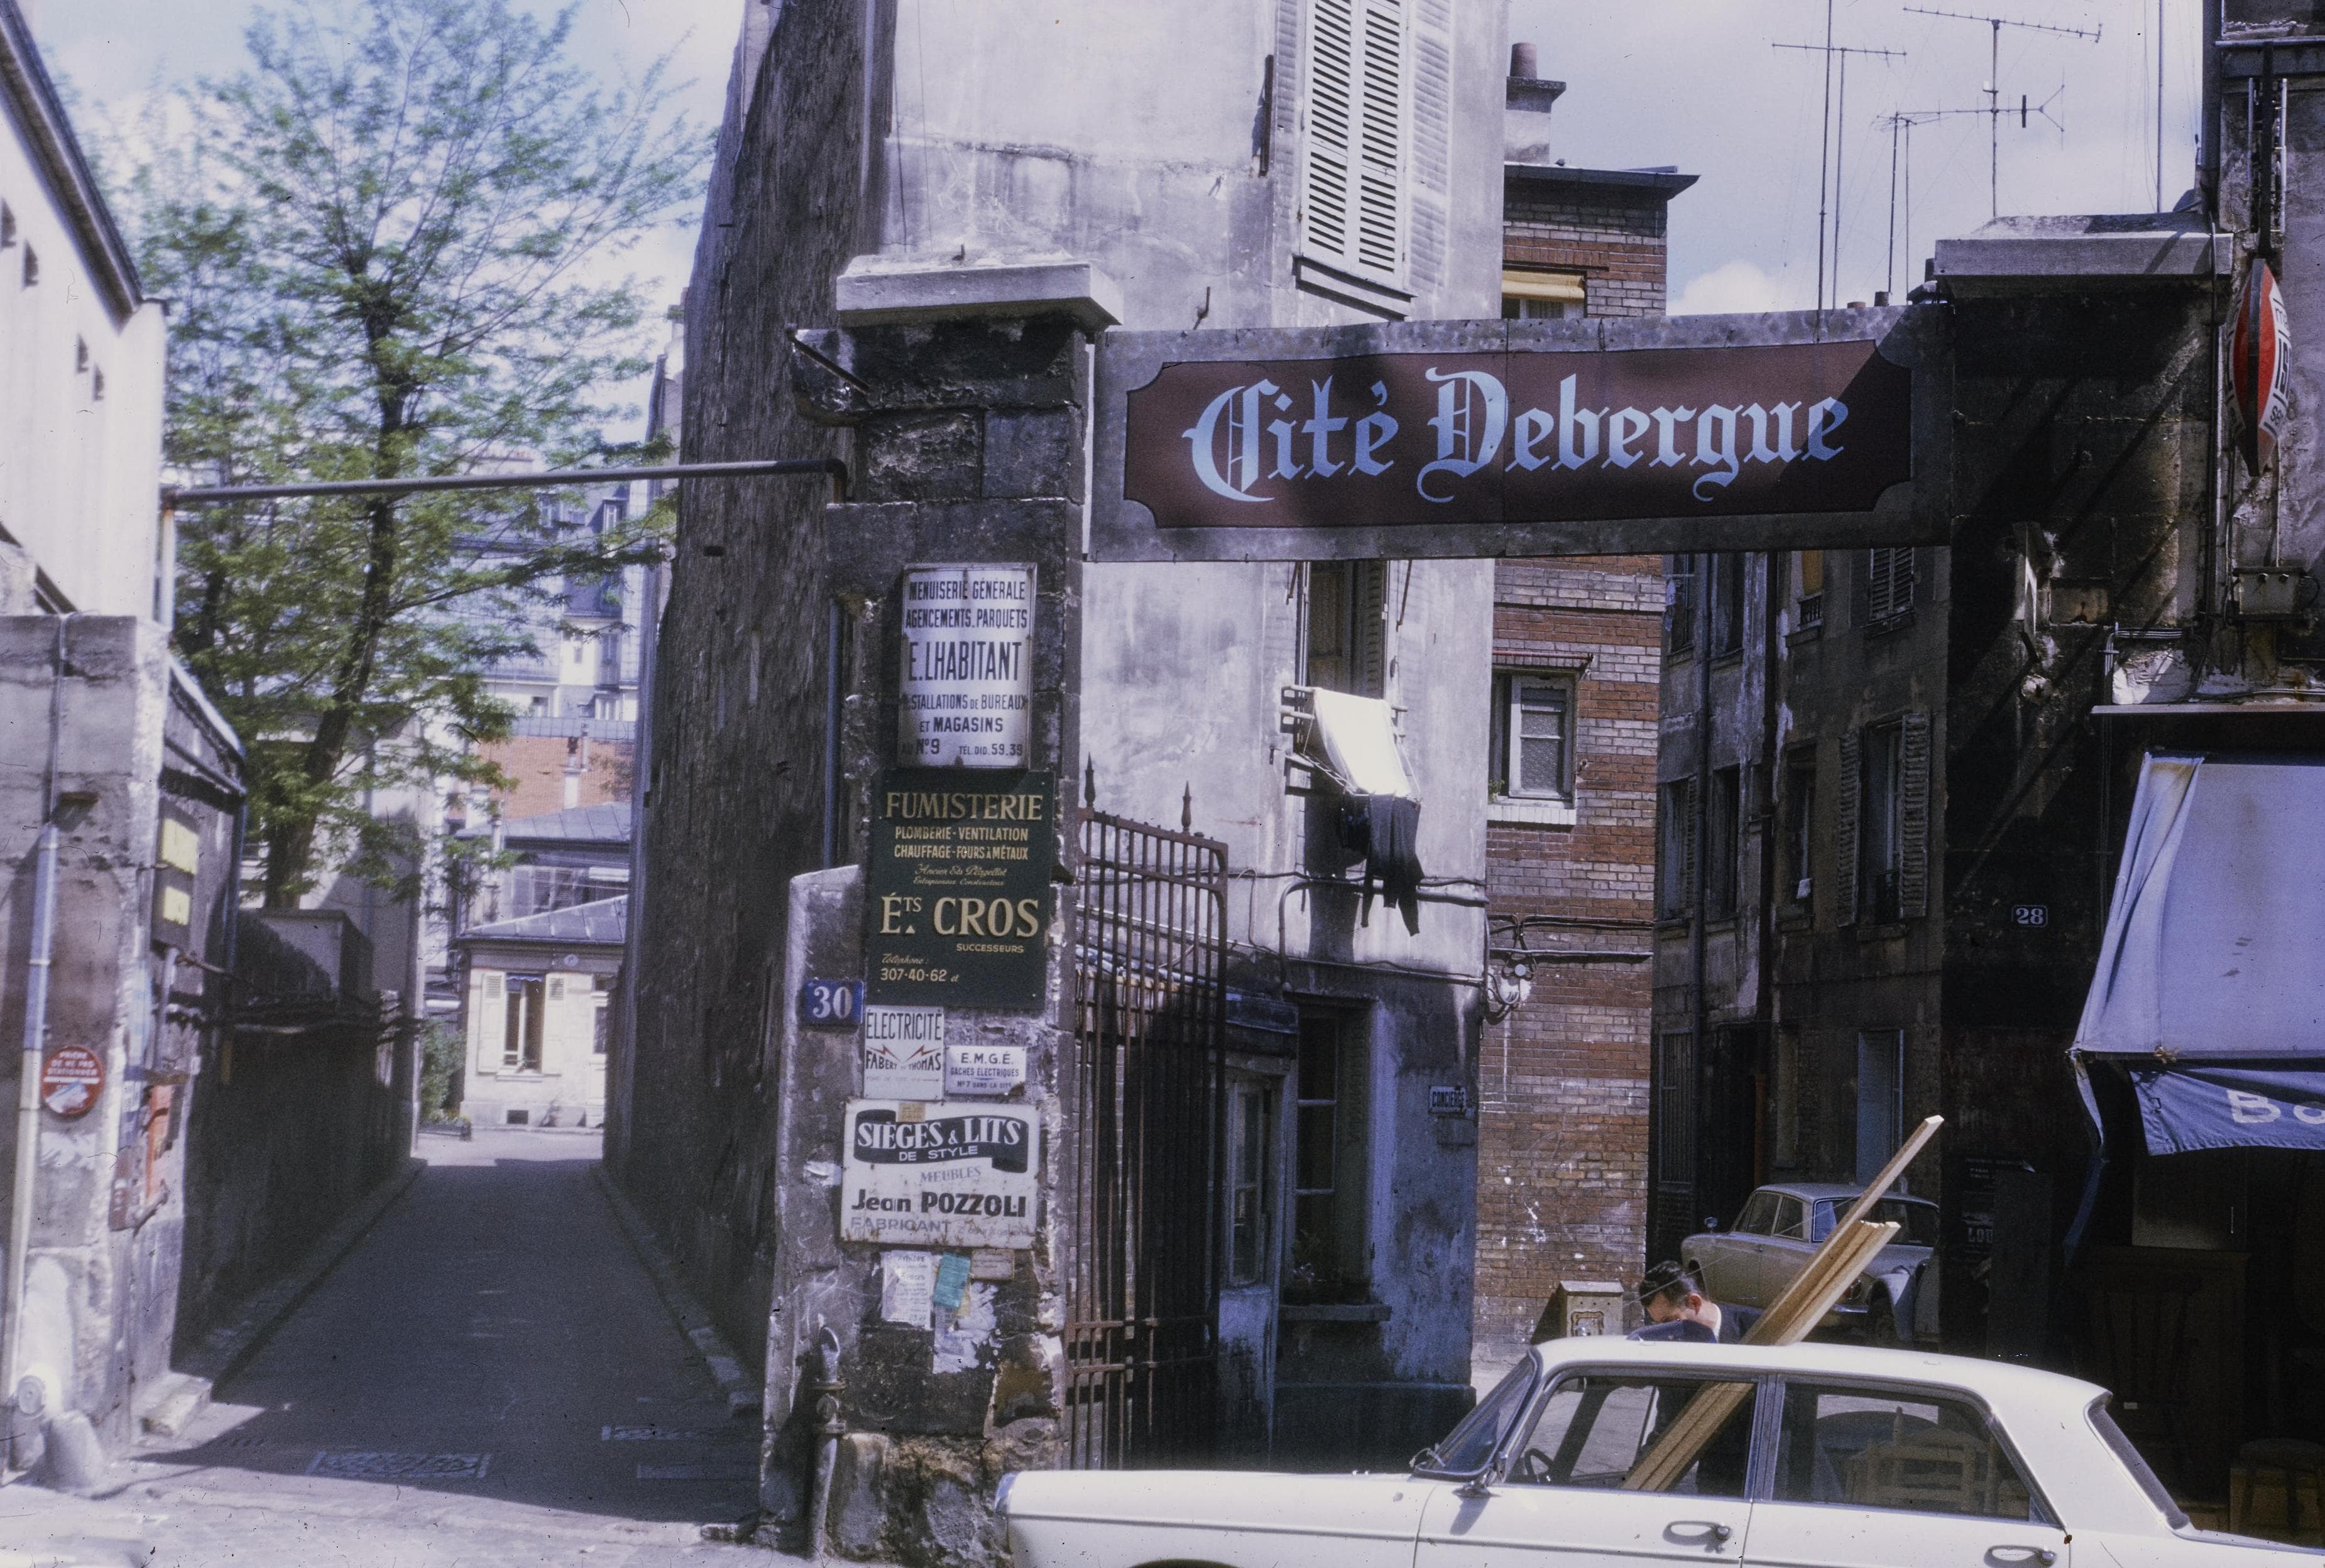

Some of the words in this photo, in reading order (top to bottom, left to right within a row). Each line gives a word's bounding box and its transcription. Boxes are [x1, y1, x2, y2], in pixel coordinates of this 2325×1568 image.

[1183, 376, 1399, 501] Cité
[1416, 366, 1849, 503] Debergue
[909, 580, 968, 600] MENUISERIE
[972, 578, 1026, 600] GÉNÉRALE
[977, 609, 1027, 629] PARQUETS
[970, 700, 979, 710] DE
[981, 695, 1027, 710] BUREAUX
[919, 721, 930, 732] ET
[933, 717, 1004, 732] MAGASINS
[885, 792, 1044, 821] FUMISTERIE
[934, 897, 1039, 937] CROS
[2015, 907, 2044, 925] 28
[956, 943, 1024, 954] SUCCESSEURS
[812, 986, 853, 1020] 30
[865, 1049, 897, 1069] FABERT
[908, 1052, 942, 1071] THOMAS
[948, 1129, 958, 1145] &
[962, 1116, 1021, 1145] LITS
[899, 1151, 917, 1162] DE
[928, 1145, 978, 1159] STYLE
[920, 1166, 982, 1183] MEUBLES
[851, 1189, 911, 1212] Jean
[921, 1191, 1026, 1217] POZZOLI
